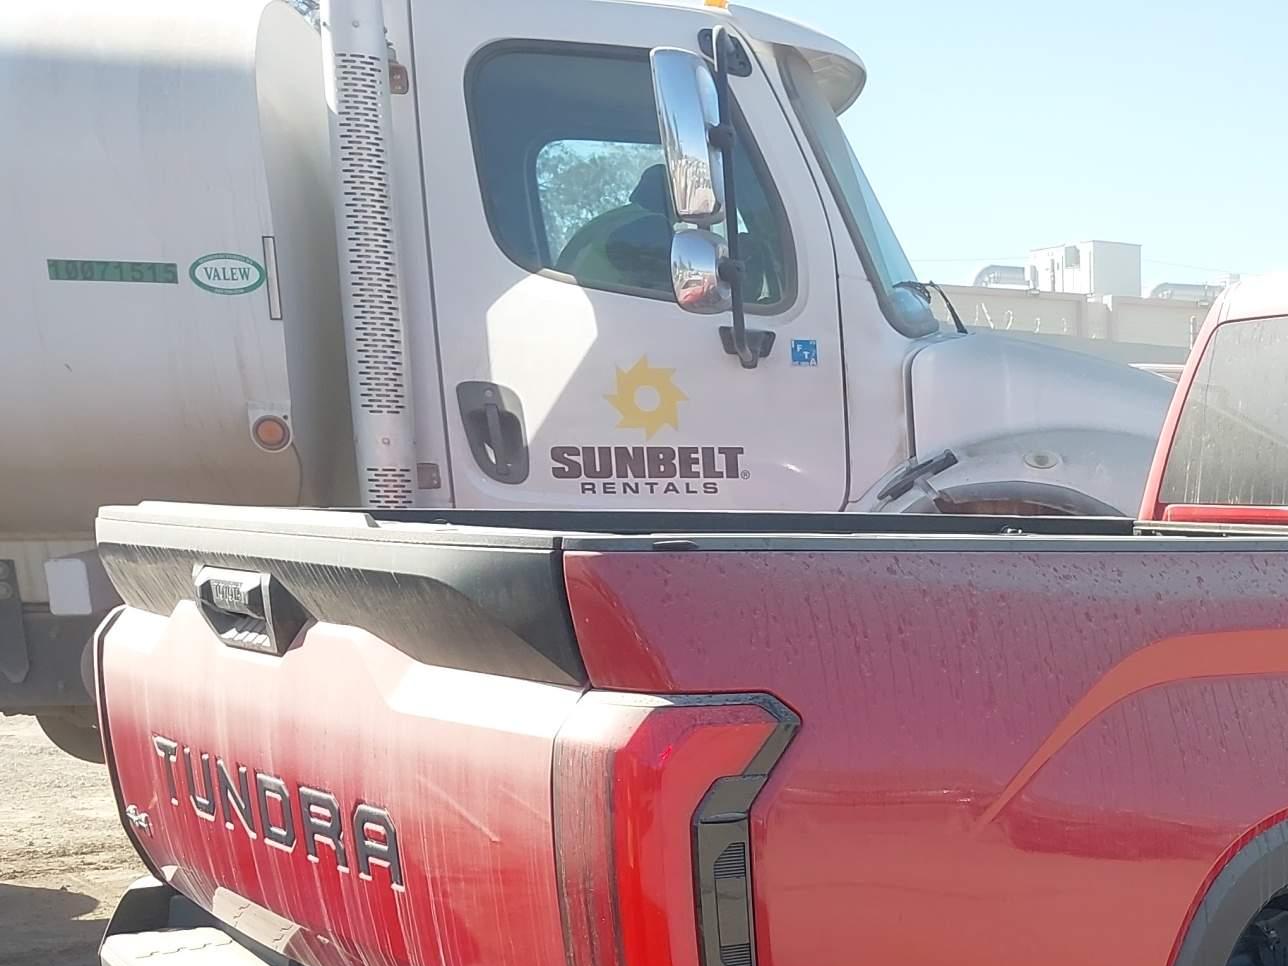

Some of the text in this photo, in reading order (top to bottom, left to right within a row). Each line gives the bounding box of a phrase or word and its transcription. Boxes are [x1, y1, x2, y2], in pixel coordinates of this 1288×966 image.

[203, 266, 250, 281] VALEW
[580, 482, 719, 495] RENTALS
[151, 733, 405, 892] TUNDRA
